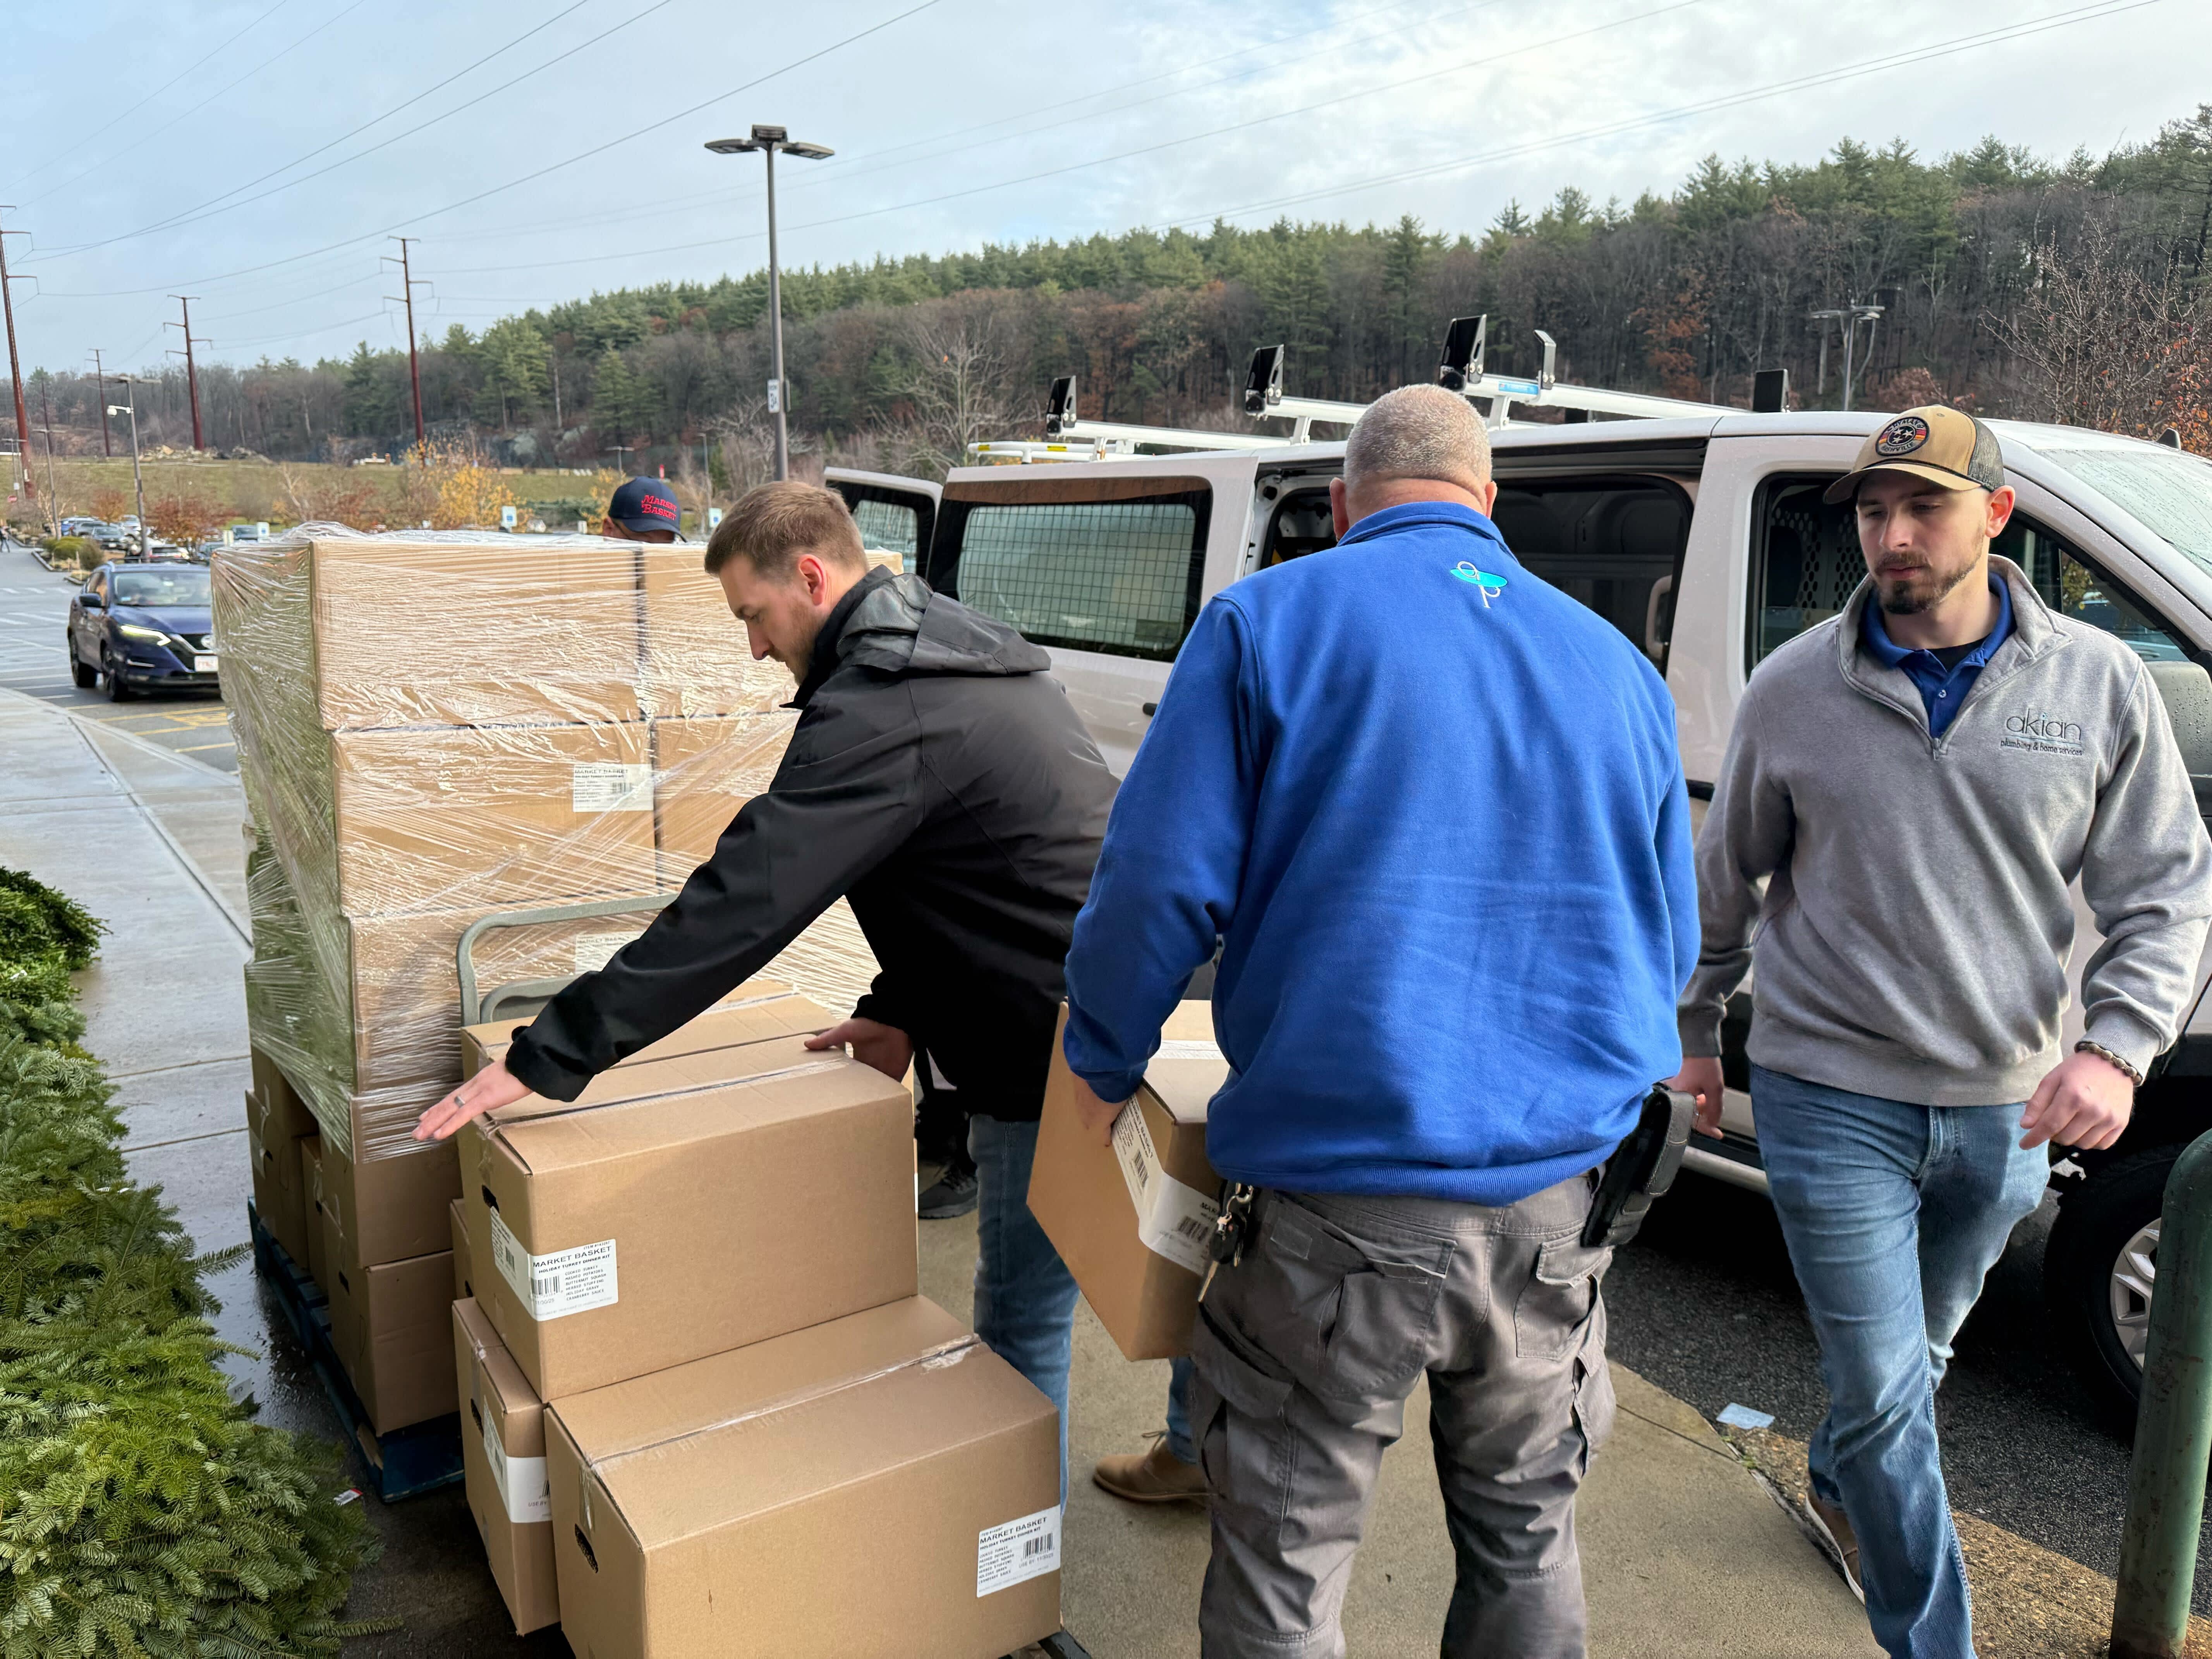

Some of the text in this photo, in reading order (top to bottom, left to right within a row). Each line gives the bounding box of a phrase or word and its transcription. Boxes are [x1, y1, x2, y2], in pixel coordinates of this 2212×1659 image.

[641, 495, 677, 511] MARKET
[641, 504, 676, 520] BASKET
[2006, 708, 2081, 740] akian
[2001, 737, 2082, 756] plumbing & home services
[533, 1246, 611, 1267] MARKET BASKET
[539, 1265, 560, 1273] HOLIDAY
[565, 1278, 588, 1286] BUTTERNUT
[566, 1292, 589, 1301] CRANBERRY
[980, 1517, 1047, 1544] MARKET BASKET
[980, 1541, 998, 1551] HOLIDAY
[1000, 1535, 1015, 1544] TURKEY
